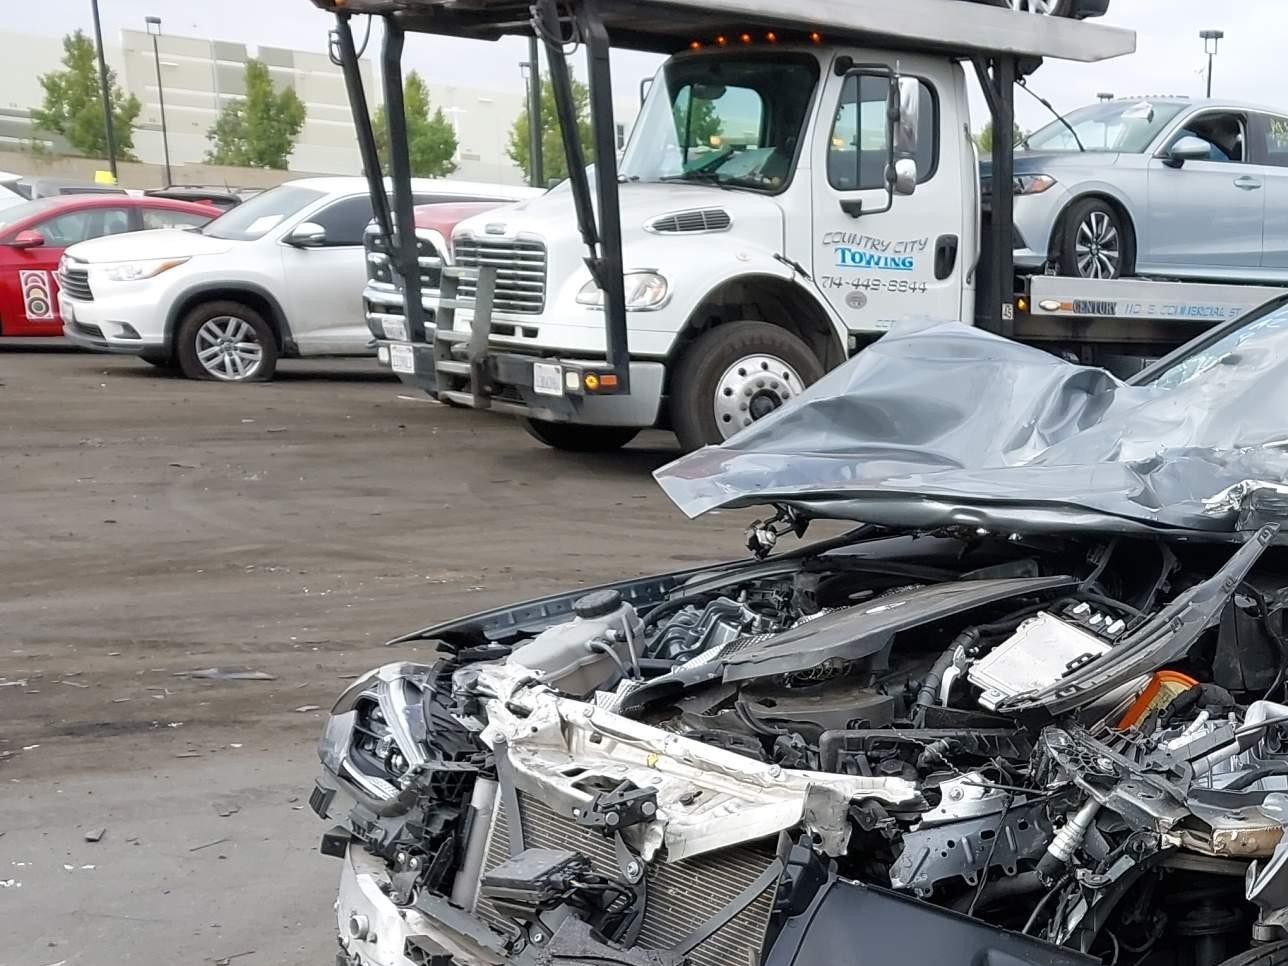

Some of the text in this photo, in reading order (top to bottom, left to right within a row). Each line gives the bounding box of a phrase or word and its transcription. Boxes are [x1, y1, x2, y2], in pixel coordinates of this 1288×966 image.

[822, 231, 929, 254] COUNTRY CITY
[834, 247, 914, 269] TOWING
[1072, 300, 1117, 316] CENTURY
